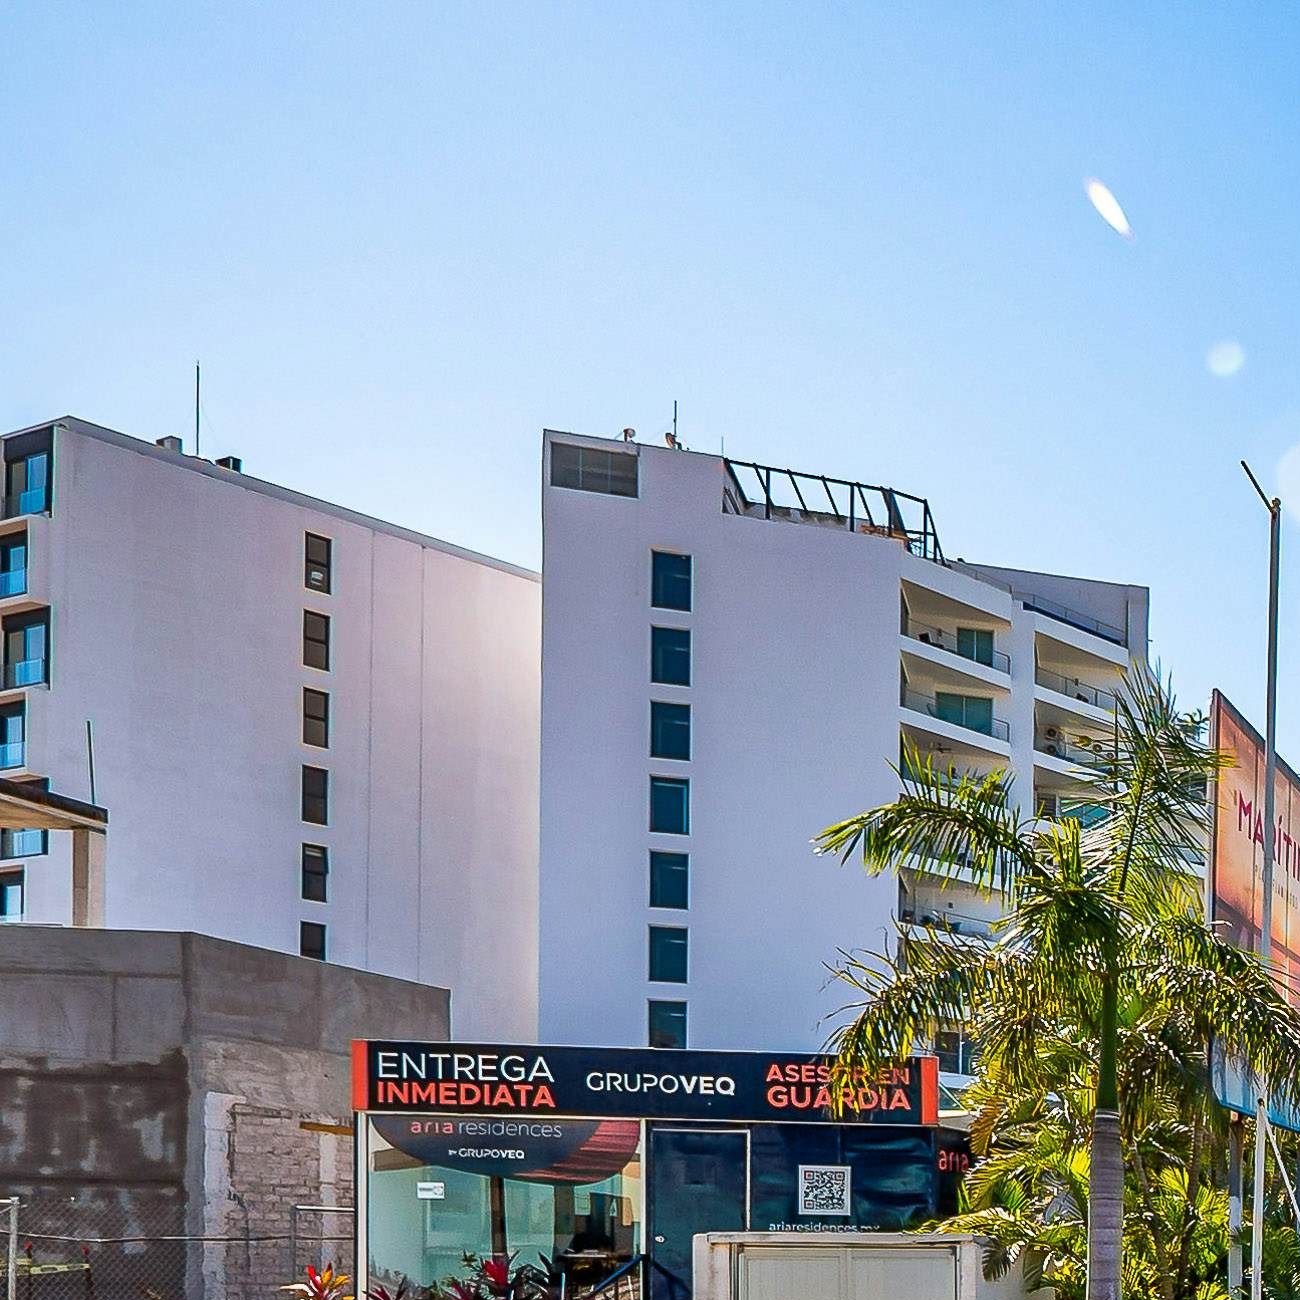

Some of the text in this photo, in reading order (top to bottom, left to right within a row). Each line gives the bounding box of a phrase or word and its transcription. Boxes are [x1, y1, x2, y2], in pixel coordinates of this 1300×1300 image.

[378, 1052, 555, 1083] ENTREGA
[377, 1081, 557, 1109] INMEDIATA
[586, 1072, 736, 1096] GRUPOVEQ
[767, 1085, 912, 1111] GUARDIA
[411, 1121, 563, 1138] aria residences
[458, 1148, 525, 1160] GRUPOVEQ
